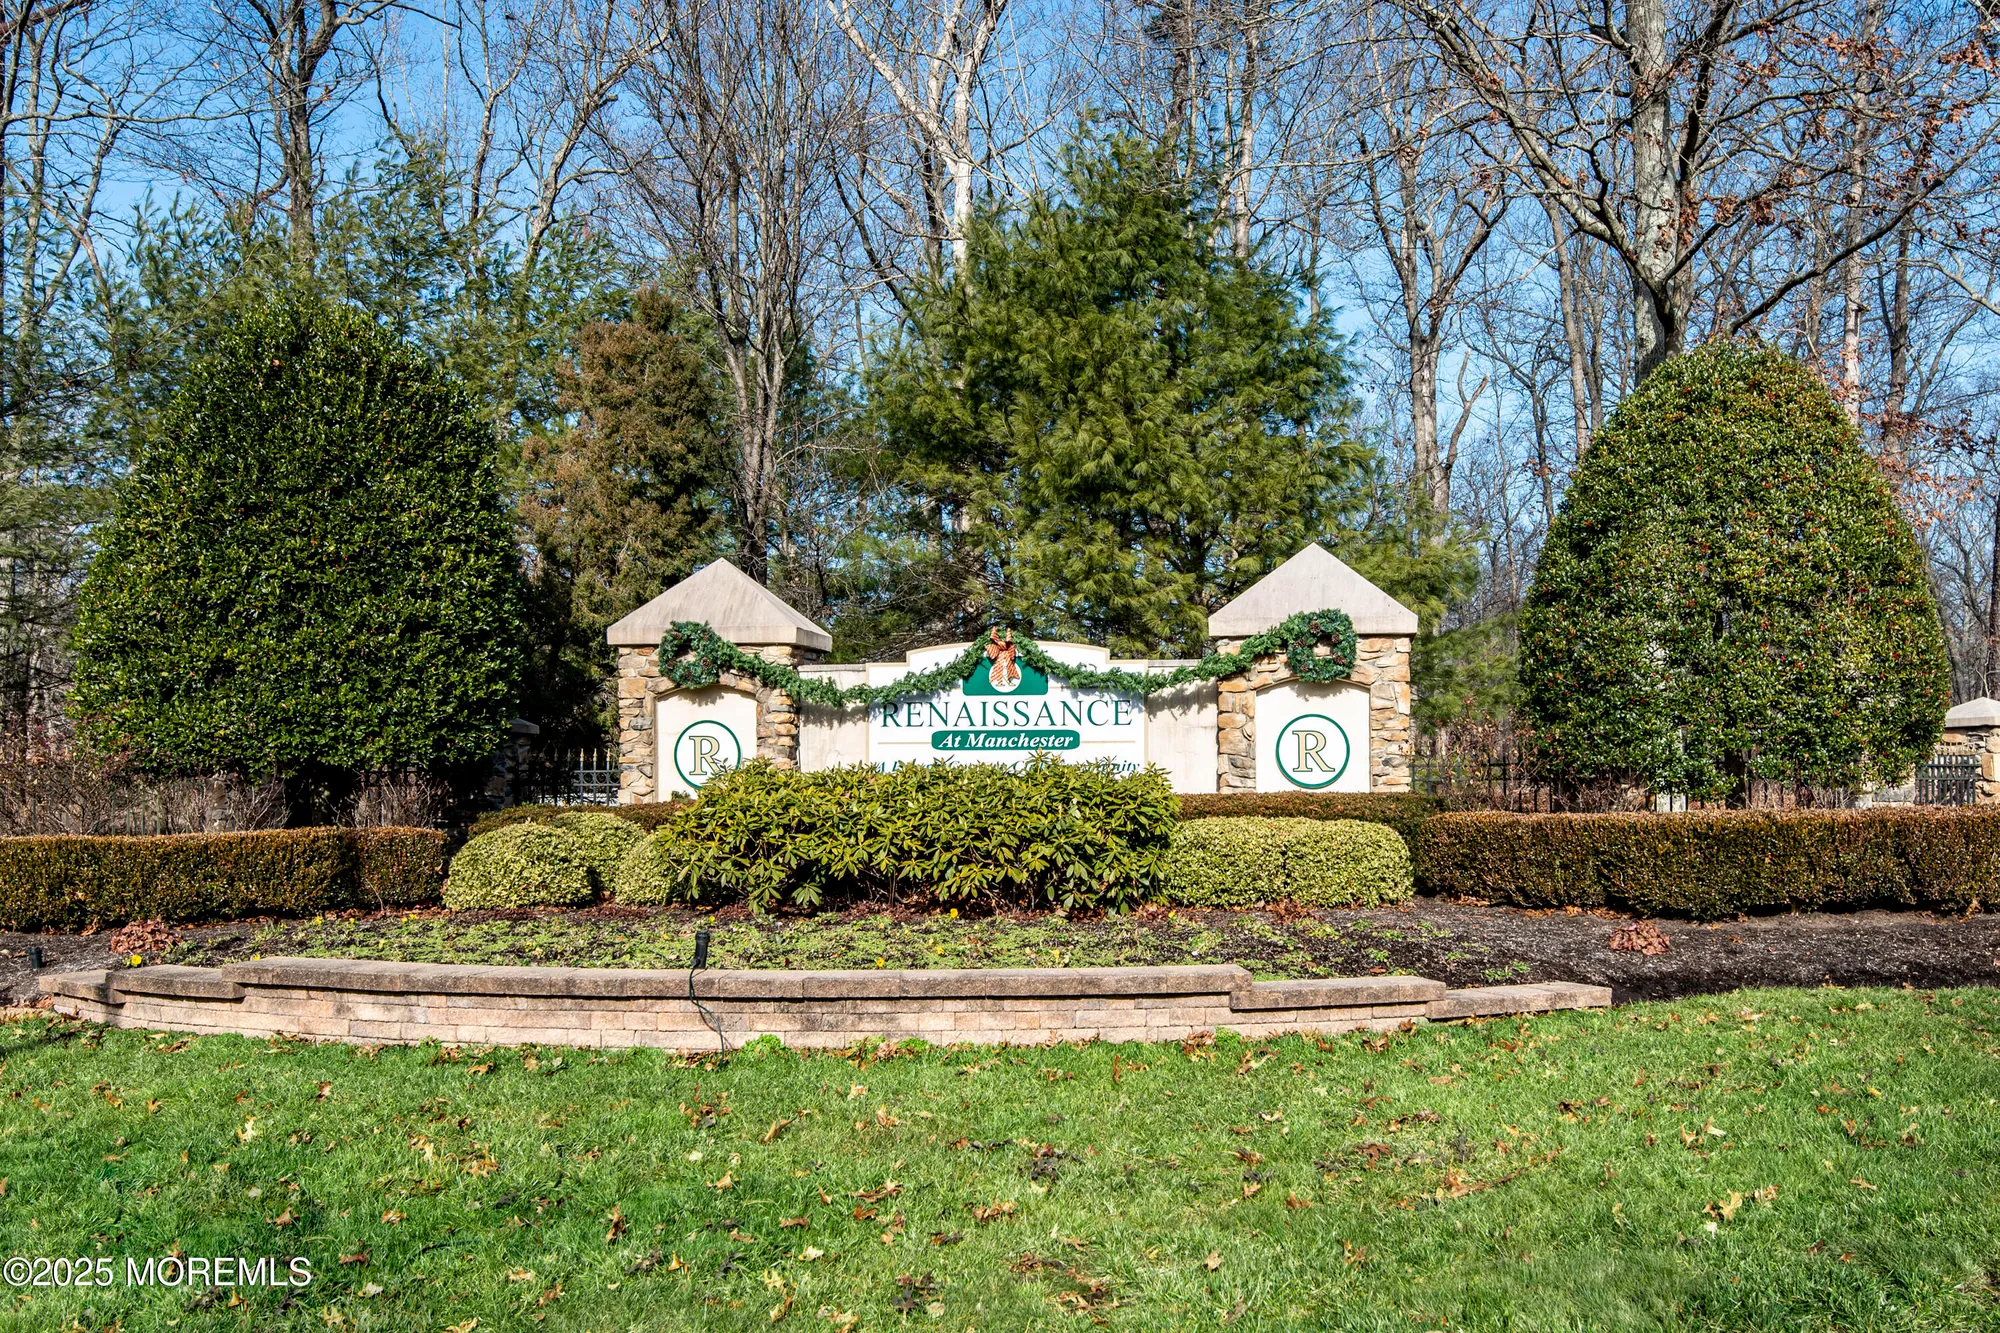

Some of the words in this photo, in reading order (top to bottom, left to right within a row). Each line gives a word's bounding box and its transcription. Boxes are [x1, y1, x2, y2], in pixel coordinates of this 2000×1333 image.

[881, 700, 1132, 727] RENAISSANCE
[688, 735, 725, 775] R
[938, 733, 961, 748] At
[966, 733, 1073, 749] Manchester
[1292, 730, 1335, 772] R
